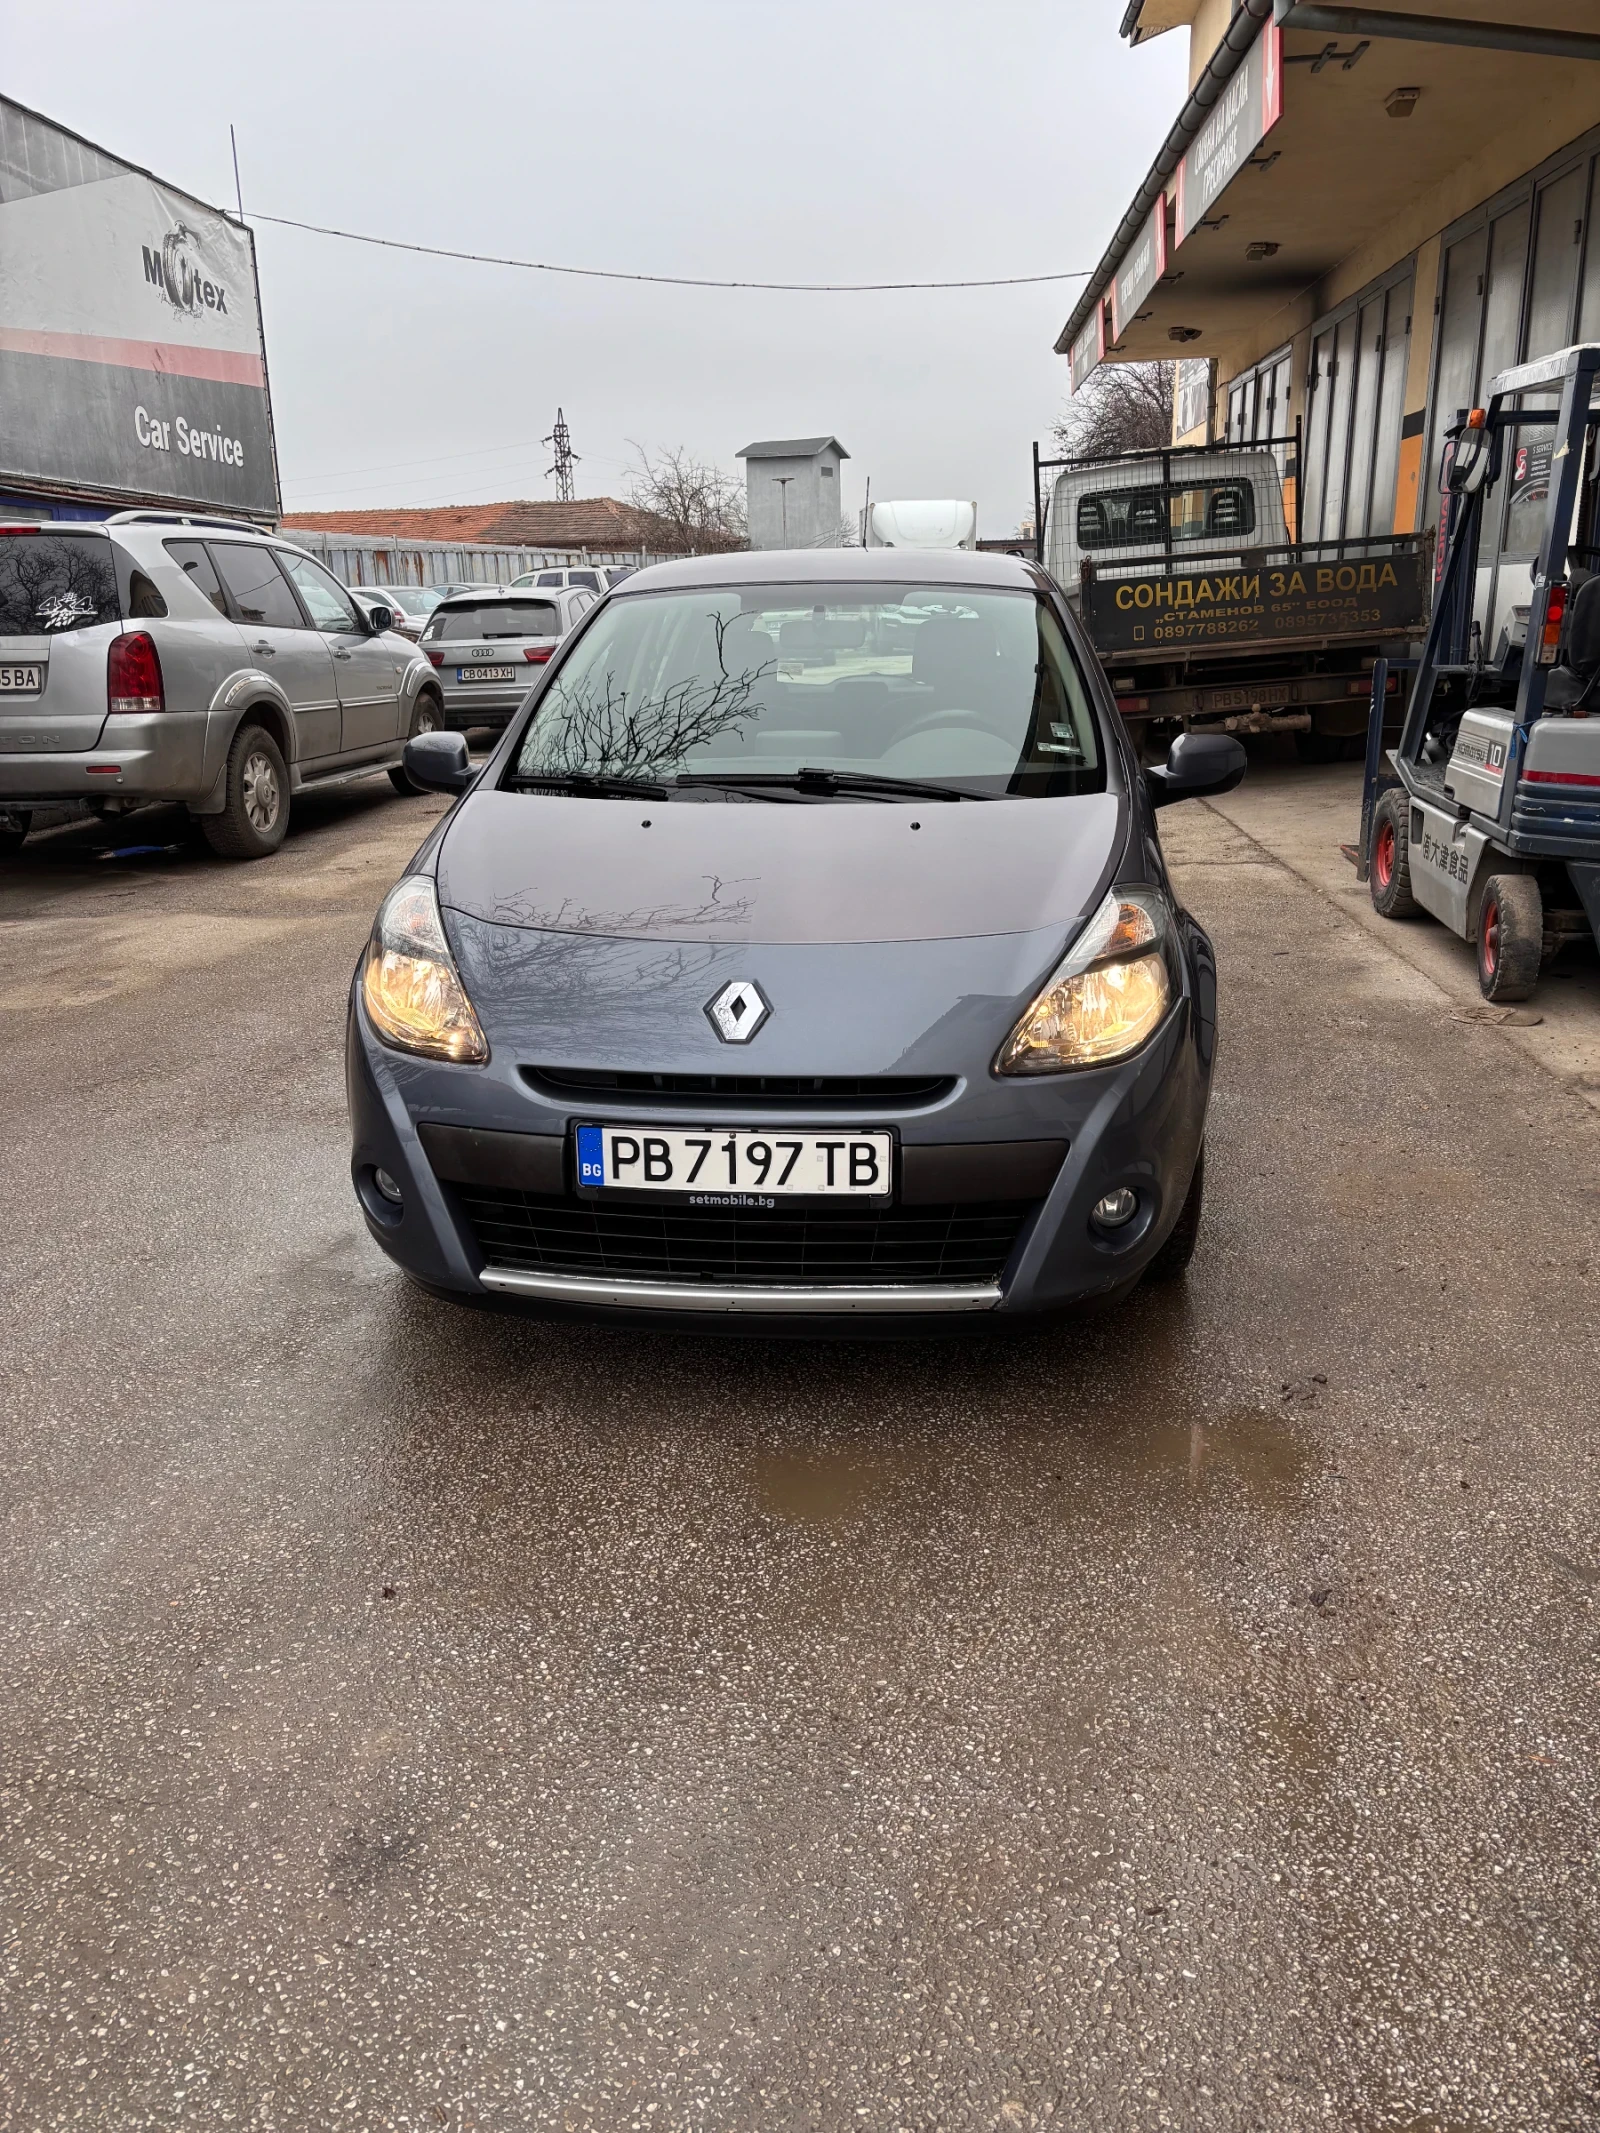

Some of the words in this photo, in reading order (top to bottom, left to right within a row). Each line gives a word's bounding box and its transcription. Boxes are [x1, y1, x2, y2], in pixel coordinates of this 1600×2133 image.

[135, 405, 170, 451] Car
[176, 416, 244, 468] Service
[1115, 574, 1260, 610] СОНДАЖИ
[1269, 571, 1307, 597] ЗА
[1316, 563, 1399, 594] ВОДА
[1306, 597, 1359, 610] ЕООД
[1153, 619, 1259, 639] 0897788262
[14, 669, 36, 687] BA
[463, 669, 476, 679] CB
[476, 668, 499, 679] 0413
[500, 667, 513, 678] XH
[1490, 744, 1502, 767] 10
[582, 1163, 602, 1177] BG
[611, 1135, 673, 1182] PB
[684, 1139, 804, 1186] 7197
[815, 1141, 879, 1187] TB
[689, 1194, 775, 1208] setmobile.bg
